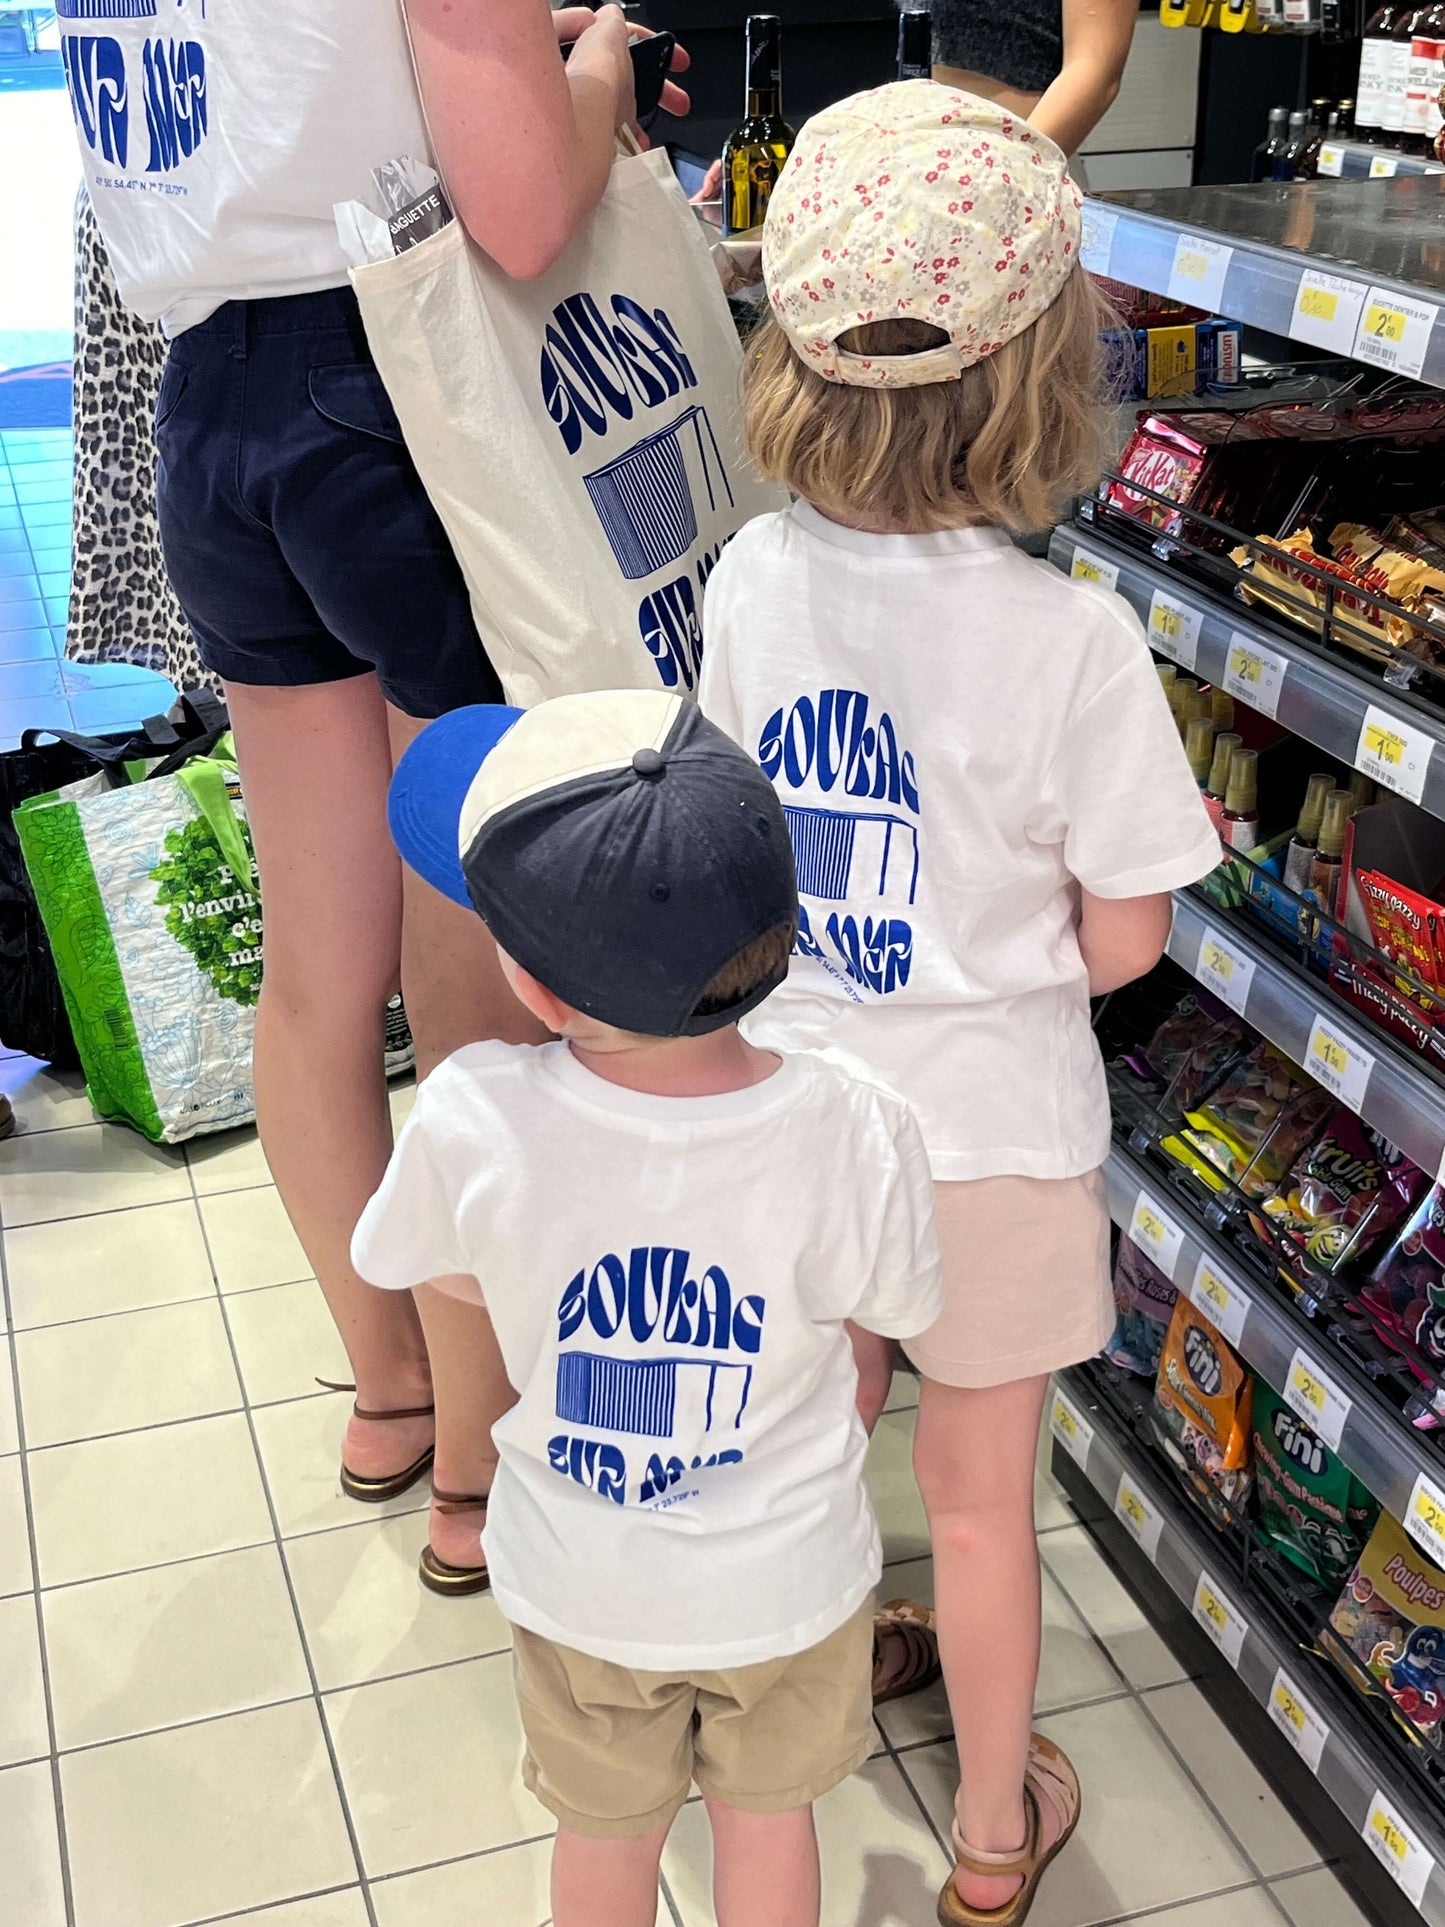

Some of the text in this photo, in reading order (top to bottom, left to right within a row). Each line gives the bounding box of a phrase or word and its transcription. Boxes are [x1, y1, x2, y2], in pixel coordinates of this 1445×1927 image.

[61, 34, 129, 169] UR
[558, 1246, 765, 1353] SOULAC
[1186, 1329, 1220, 1393] Fini
[1275, 1411, 1324, 1473] Fini
[1383, 1553, 1445, 1610] Poulpes
